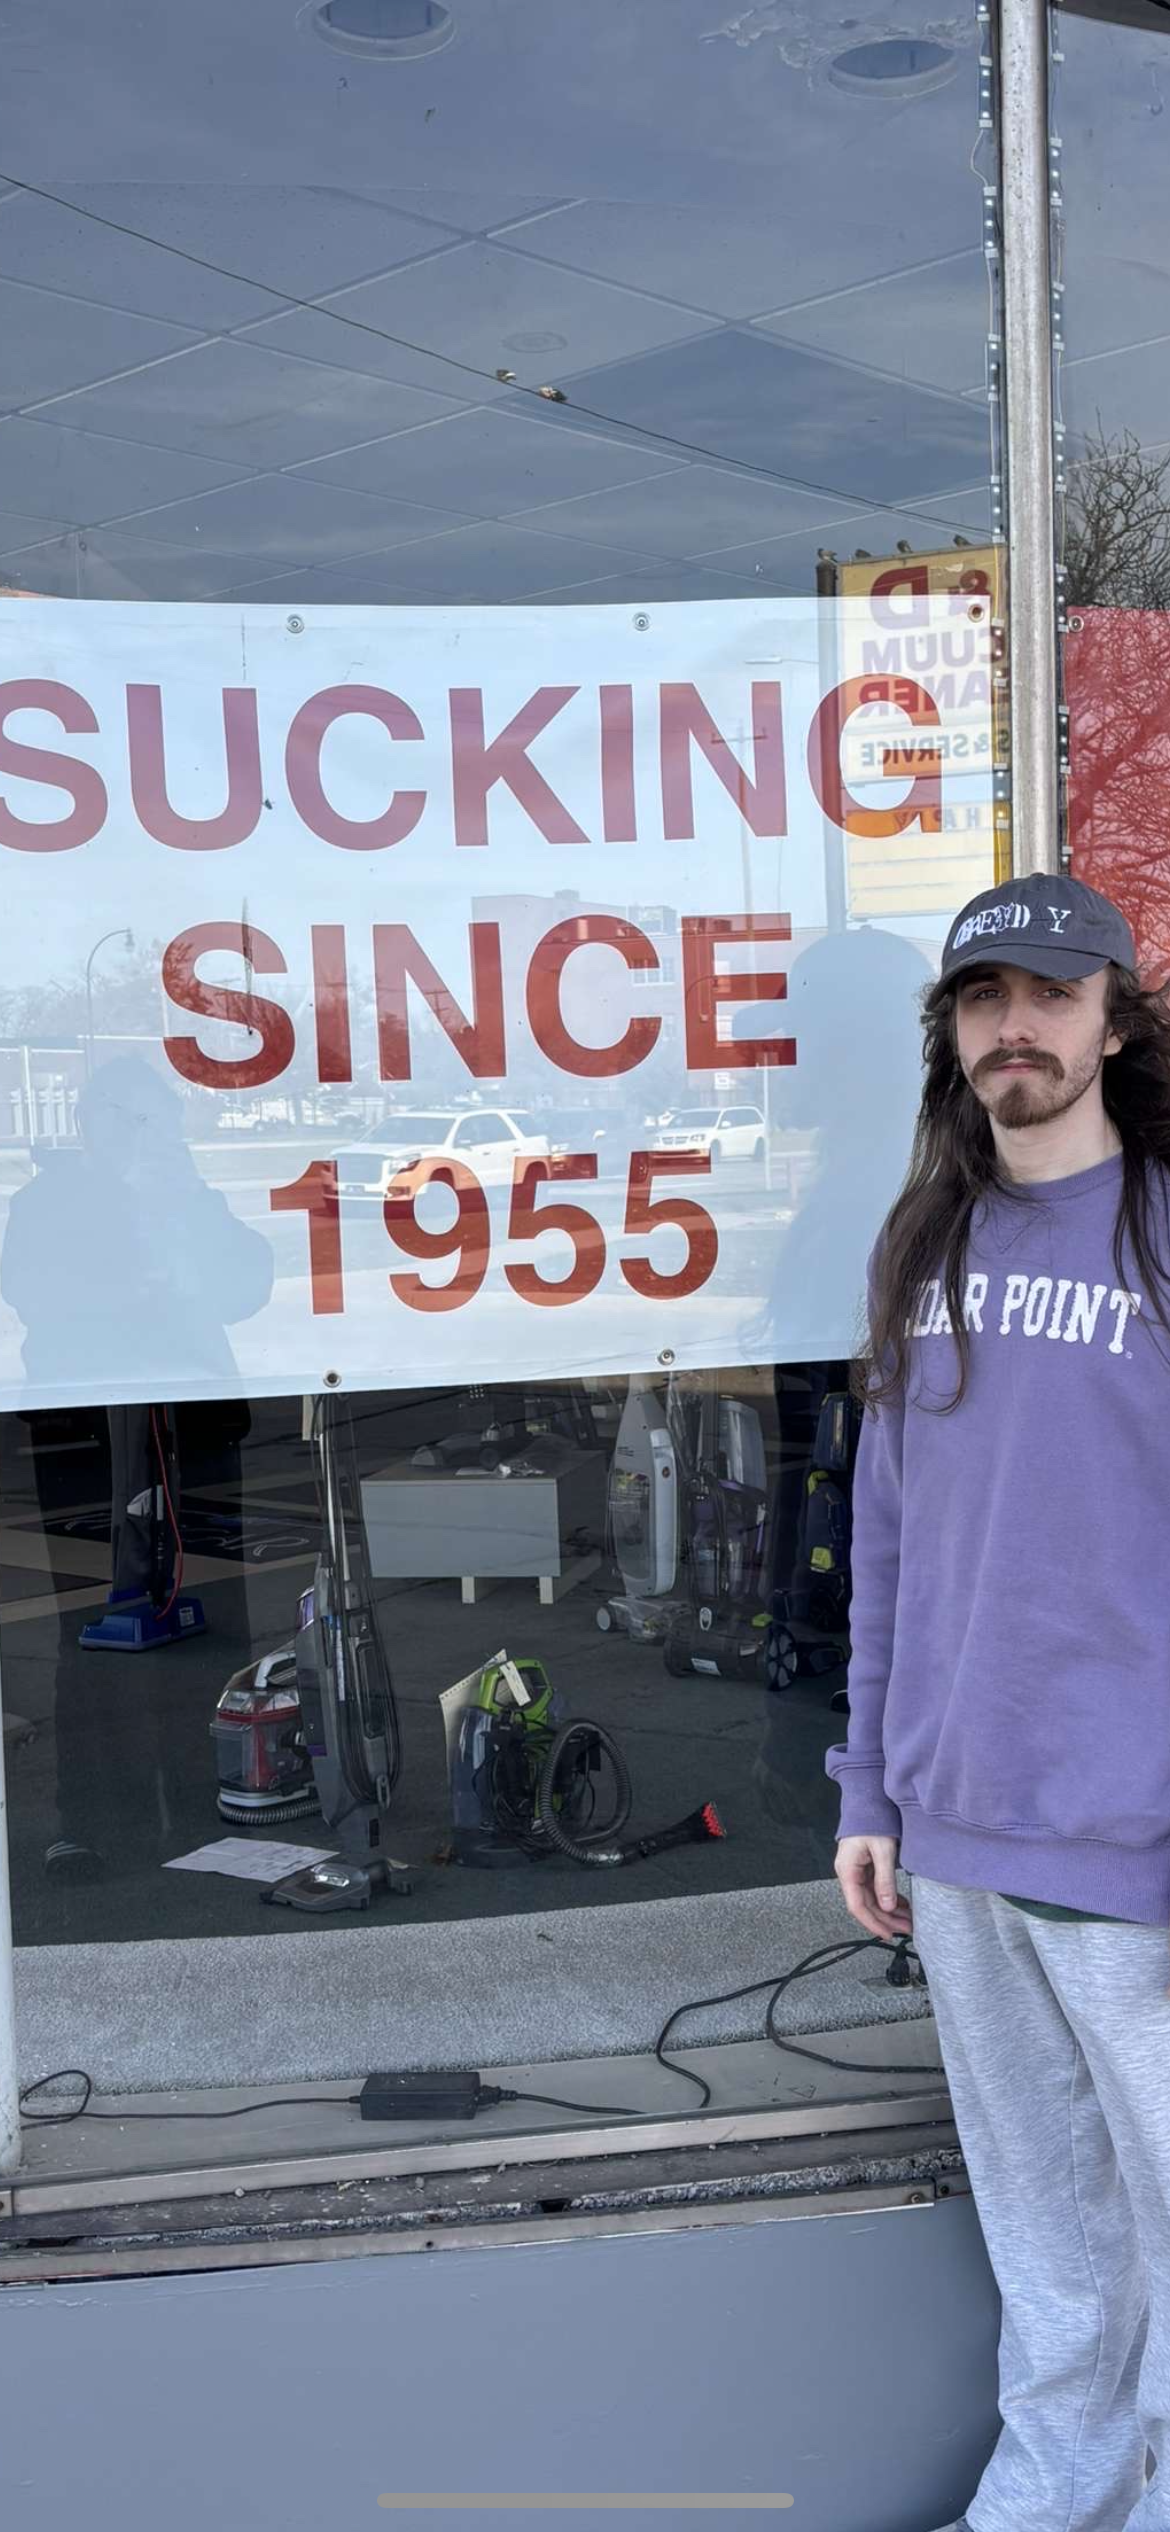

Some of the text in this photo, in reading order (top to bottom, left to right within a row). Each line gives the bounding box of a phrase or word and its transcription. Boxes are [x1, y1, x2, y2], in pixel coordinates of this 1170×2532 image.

[0, 672, 943, 853] SUCKING
[161, 911, 799, 1091] SINCE
[269, 1150, 720, 1315] 1955
[1000, 1274, 1142, 1355] POINT
